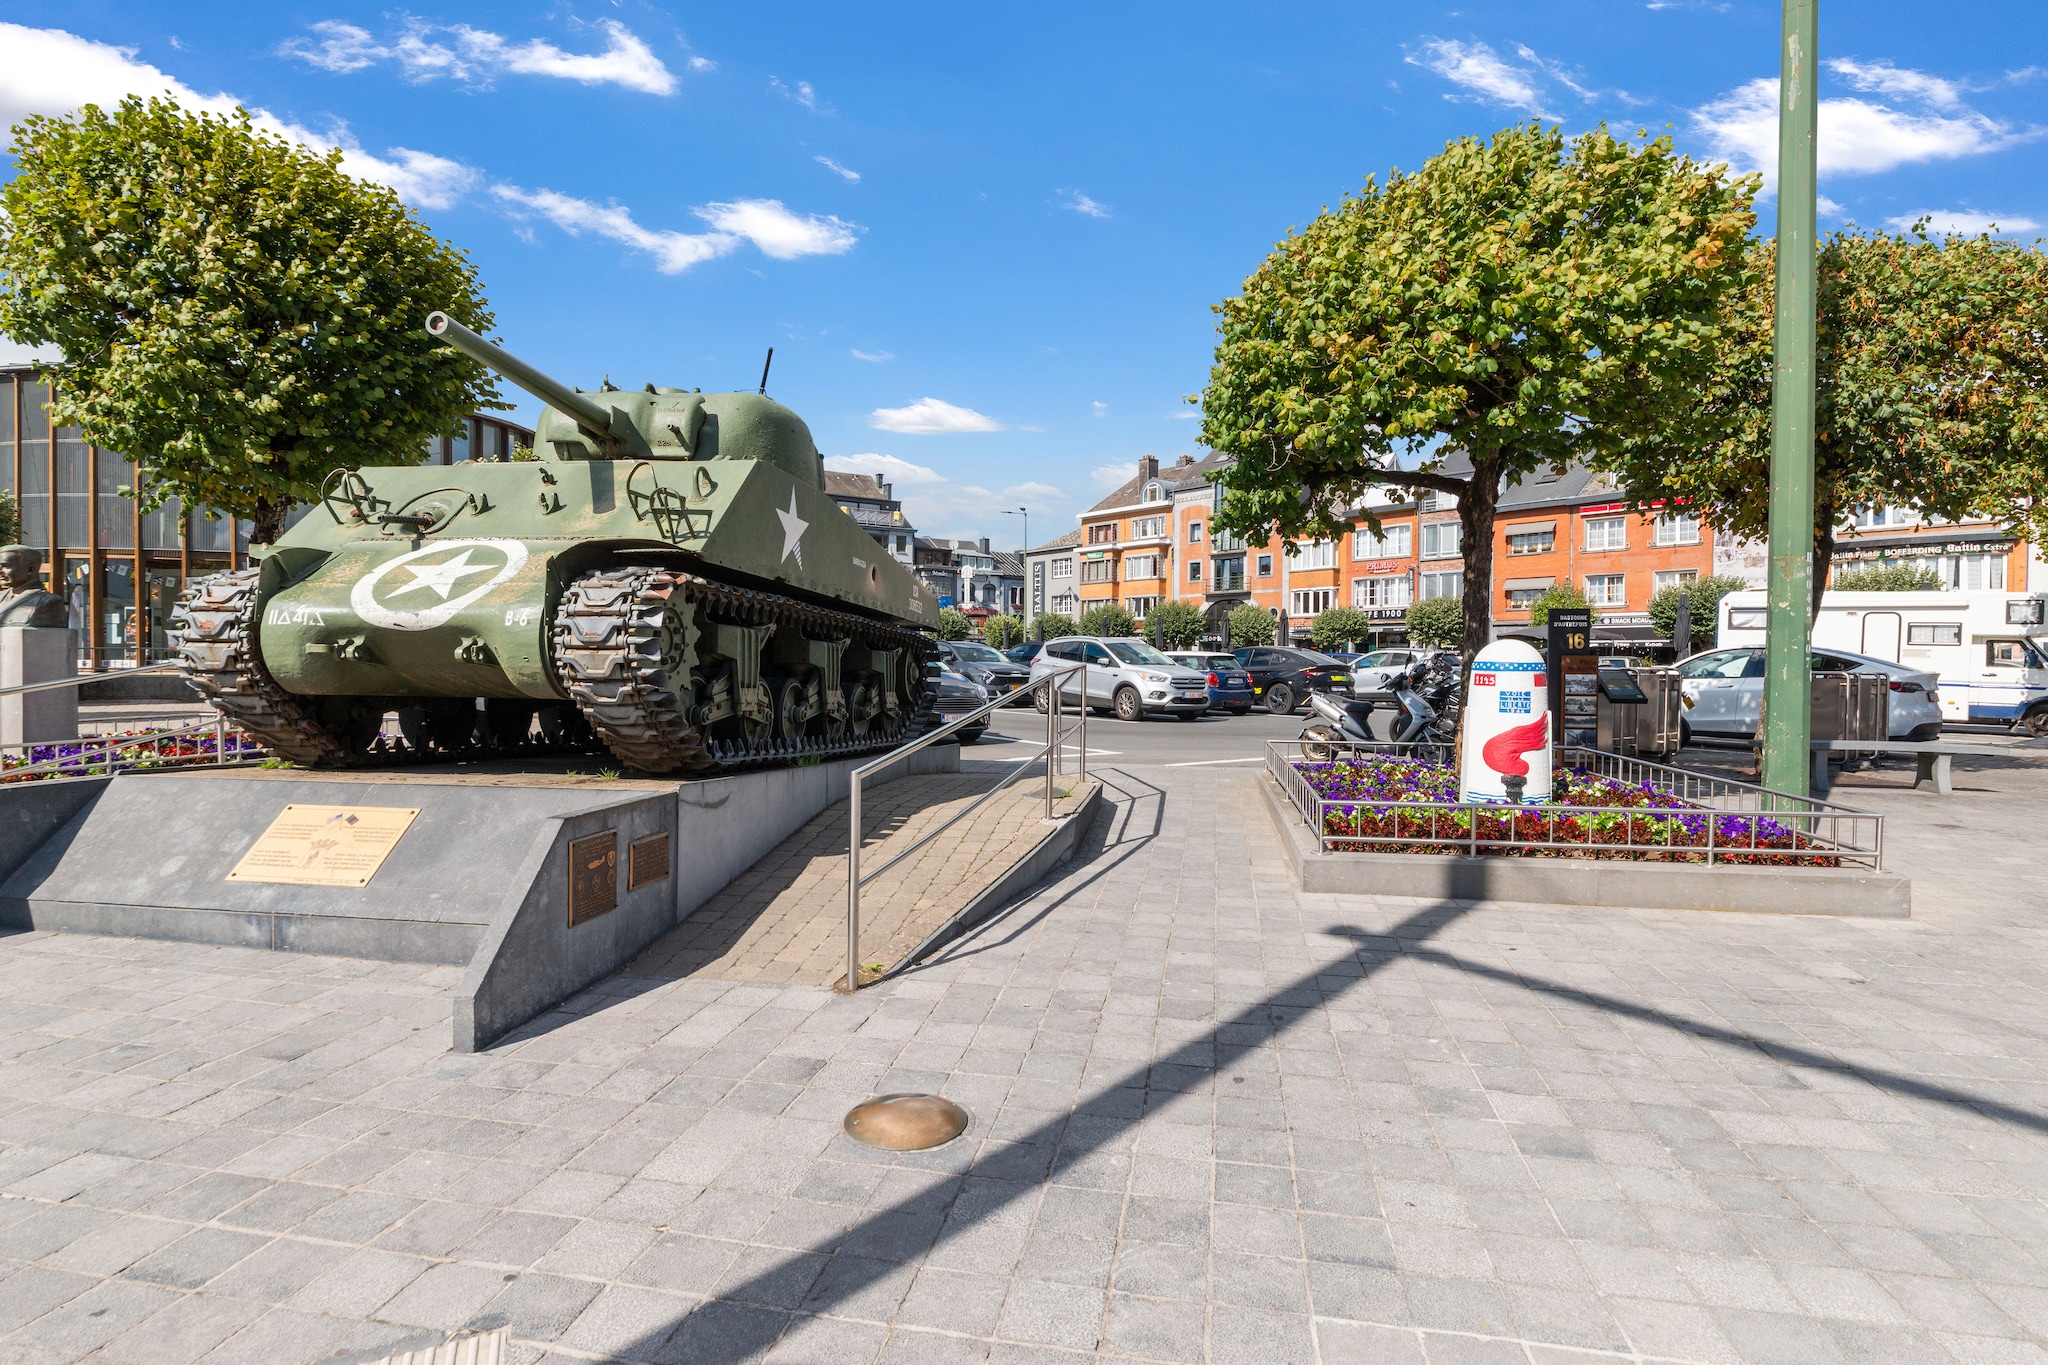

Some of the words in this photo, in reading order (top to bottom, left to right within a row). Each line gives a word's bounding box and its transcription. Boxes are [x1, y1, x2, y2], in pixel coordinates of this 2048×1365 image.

[1884, 547, 1942, 556] BOFFERDING
[1947, 543, 1981, 552] Battin
[1367, 561, 1398, 570] PRIMUS
[504, 610, 528, 627] B-6
[1382, 610, 1402, 618] 1900
[1566, 633, 1585, 649] 16
[1475, 676, 1495, 684] 1145
